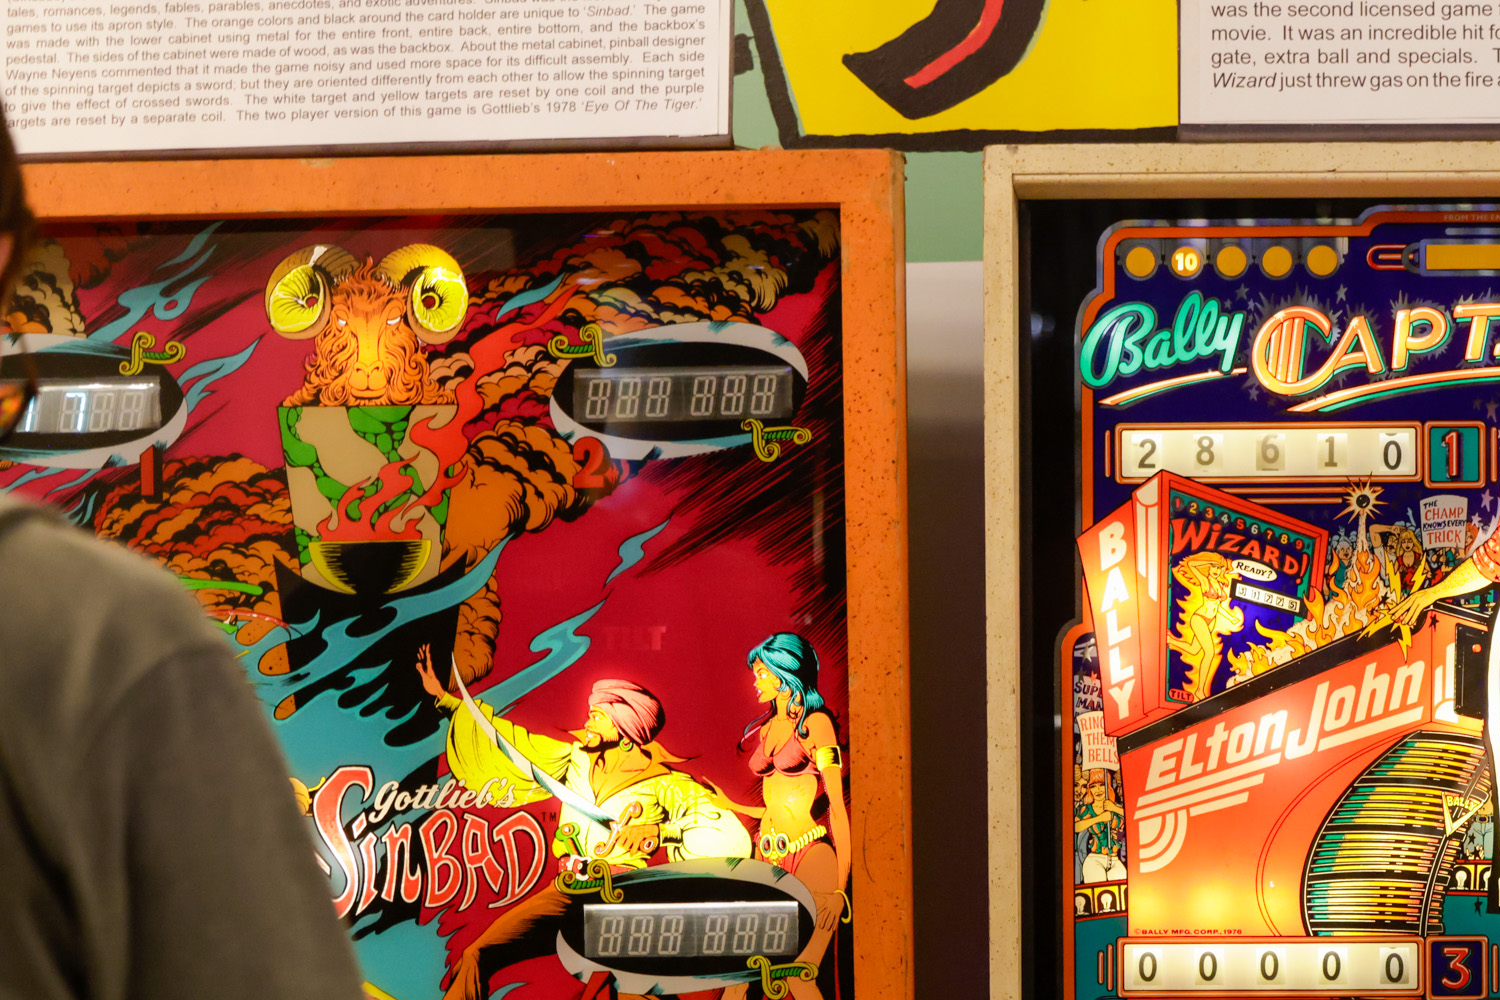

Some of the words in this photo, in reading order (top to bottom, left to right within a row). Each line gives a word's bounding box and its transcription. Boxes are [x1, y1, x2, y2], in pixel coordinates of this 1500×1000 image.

[1211, 6, 1247, 17] was
[1254, 2, 1281, 17] the
[1288, 2, 1353, 17] second
[1360, 1, 1435, 16] licensed
[1441, 5, 1492, 20] game
[1212, 25, 1270, 40] movie.
[1284, 25, 1293, 40] It
[1298, 29, 1334, 40] was
[1341, 29, 1362, 40] an
[1369, 25, 1456, 40] incredible
[1463, 25, 1484, 40] hit
[1212, 50, 1255, 68] gate,
[1265, 50, 1309, 64] extra
[1318, 49, 1348, 64] ball
[1357, 48, 1390, 63] and
[1398, 48, 1477, 67] specials.
[1213, 72, 1277, 89] Wizard
[1279, 72, 1312, 92] just
[1316, 72, 1366, 87] threw
[1370, 76, 1403, 91] gas
[1407, 76, 1428, 87] on
[1433, 72, 1461, 87] the
[1465, 71, 1493, 87] fire
[51, 118, 71, 126] are
[76, 115, 106, 125] reset
[112, 114, 125, 127] by
[131, 116, 138, 124] a
[143, 112, 196, 125] separate
[201, 111, 225, 122] coil.
[236, 110, 259, 120] The
[265, 110, 286, 120] two
[291, 109, 329, 122] player
[334, 107, 378, 118] version
[384, 106, 396, 117] of
[400, 106, 421, 116] this
[427, 107, 461, 118] game
[467, 104, 476, 115] is
[547, 101, 576, 112] 1978
[615, 100, 630, 111] Of
[635, 99, 658, 110] The
[1175, 252, 1197, 271] 10
[1080, 291, 1246, 388] Bally
[1442, 430, 1464, 479] 1
[1423, 500, 1438, 509] THE
[1424, 506, 1464, 521] CHAMP
[1447, 519, 1467, 528] EVERY
[1427, 529, 1462, 545] TRICK
[1236, 561, 1274, 579] READY?
[1099, 520, 1135, 720] BALLY
[1170, 689, 1191, 701] TILT
[1284, 660, 1425, 761] John
[1084, 732, 1116, 748] THEM
[369, 778, 516, 823] Gottlieb's
[1171, 928, 1192, 936] MFG.
[1223, 928, 1243, 936] 1976
[1440, 946, 1472, 990] 3
